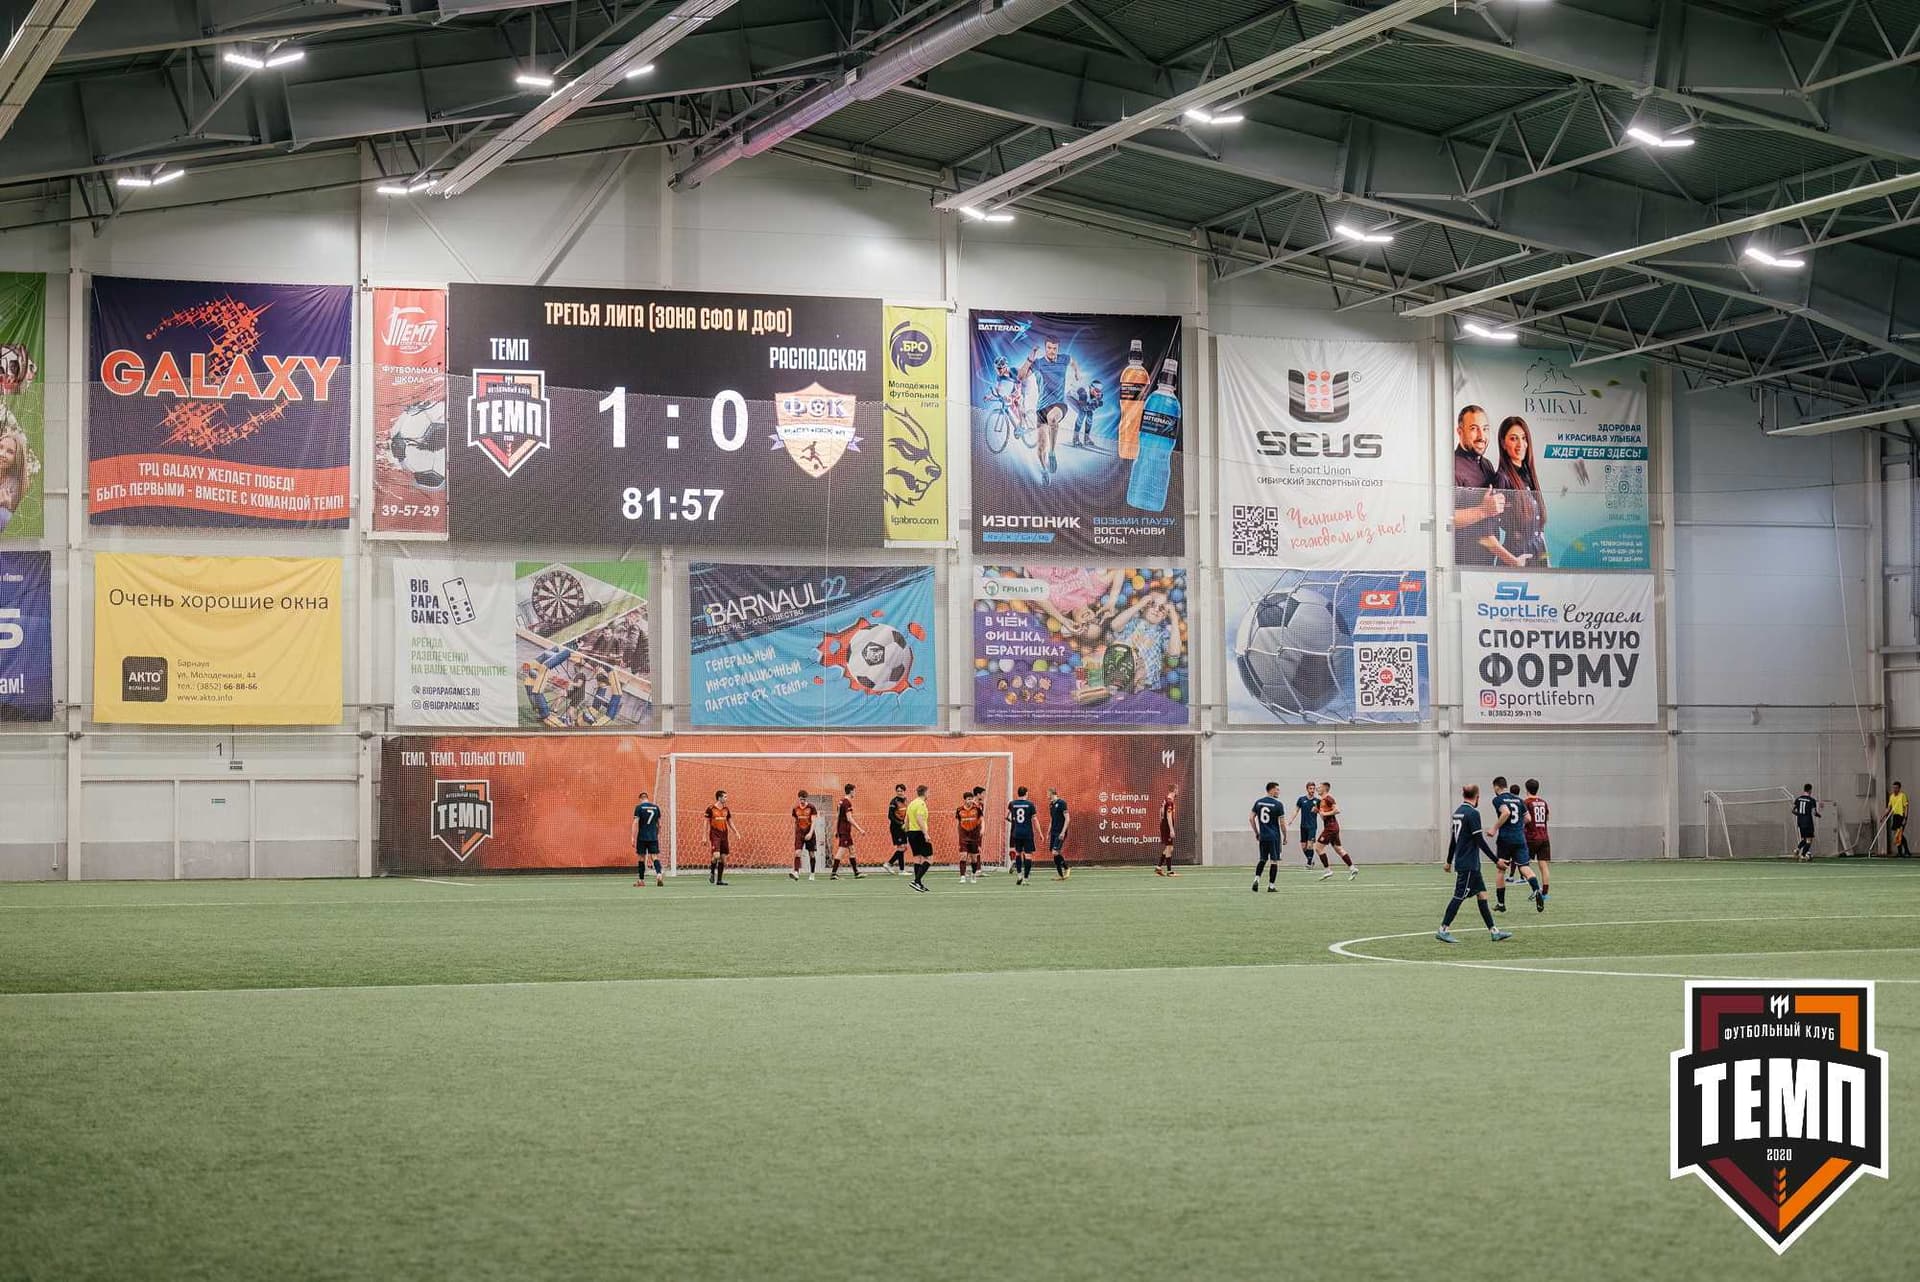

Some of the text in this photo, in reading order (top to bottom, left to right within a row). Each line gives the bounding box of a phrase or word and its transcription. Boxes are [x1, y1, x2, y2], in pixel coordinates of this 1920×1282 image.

[545, 302, 792, 337] ТРЕТЬЯ ЛИГА (ЗОНА СФО И ДФО)
[490, 338, 529, 361] ТЕМП
[770, 347, 867, 372] РАСПАДСКАЯ
[101, 350, 341, 401] GALAXY
[382, 366, 439, 374] ФУТБОЛЬНАЯ
[394, 375, 424, 384] ШКОЛА
[889, 390, 939, 399] футбольная
[1525, 398, 1587, 415] BAIKAL
[477, 400, 541, 437] ТЕМП
[598, 386, 628, 449] 1
[710, 390, 749, 453] 0
[1598, 424, 1641, 432] ЗДОРОВАЯ
[1256, 431, 1383, 459] SEUS
[1565, 433, 1607, 442] КРАСИВАЯ
[1609, 435, 1641, 443] УЛЫБКА
[1551, 447, 1641, 459] ЖДЕТ ТЕБЯ ЗДЕСЬ!
[138, 462, 295, 492] ТРЦ GALAXY ЖЕЛАЕТ ПОБЕД!
[1289, 464, 1352, 477] Export Union
[1256, 477, 1304, 487] СИБИРСКИЙ
[1306, 478, 1360, 487] ЭКСПОРТНЫЙ
[96, 485, 127, 502] БЫТЬ
[130, 482, 184, 498] ПЕРВЫМИ
[195, 486, 238, 504] ВМЕСТЕ
[240, 491, 248, 504] С
[250, 492, 310, 512] КОМАНДОЙ
[314, 495, 344, 511] ТЕМП!
[622, 487, 724, 521] 81:57
[381, 505, 440, 517] 39-57-29
[1286, 507, 1353, 528] Чемпион
[982, 515, 1081, 529] ИЗОТОНИК
[1093, 517, 1140, 526] ВОЗЬМИ
[1094, 527, 1166, 536] ВОССТАНОВИ
[1290, 514, 1407, 549] каждом из нас!
[1094, 536, 1127, 545] СИЛЫ.
[410, 579, 429, 593] BIG
[1495, 582, 1540, 601] SL
[109, 588, 329, 613] Очень хорошие окна
[411, 595, 440, 609] PAPA
[411, 609, 449, 625] GAMES
[985, 612, 1028, 627] В ЧЁМ
[1478, 603, 1558, 620] SportLife
[1562, 603, 1645, 629] Создаем
[411, 637, 443, 649] АРЕНДА
[985, 631, 1045, 644] ФИШКА,
[1478, 629, 1641, 649] СПОРТИВНУЮ
[705, 645, 777, 673] ГЕНЕРАЛЬНЫЙ
[985, 645, 1066, 657] БРАТИШКА?
[177, 659, 210, 668] Барнаул
[1478, 652, 1640, 688] ФОРМУ
[128, 672, 161, 683] АКТО
[705, 660, 801, 694] ИНФОРМАЦИОННЫЙ
[223, 682, 258, 690] 66-88-66
[177, 694, 233, 703] www.akto.info
[705, 679, 809, 713] ПАРТНЕР ФК «ТЕМП»
[1499, 690, 1595, 709] sportlifebrn
[422, 701, 480, 711] @BIGPAPAGAMES
[216, 742, 222, 756] 1
[1317, 740, 1325, 753] 2
[400, 752, 525, 768] ТЕМП, ТЕМП, ТОЛЬКО ТЕМП!
[1111, 792, 1149, 803] fctemp.ru
[1111, 806, 1147, 815] ФК Темп
[1260, 806, 1271, 824] 6
[1510, 803, 1519, 824] 3
[1534, 807, 1546, 823] 88
[1800, 801, 1807, 814] 11
[437, 802, 488, 831] ТЕМП
[647, 809, 655, 825] 7
[1016, 808, 1025, 824] 8
[1111, 821, 1141, 831] fc.temp
